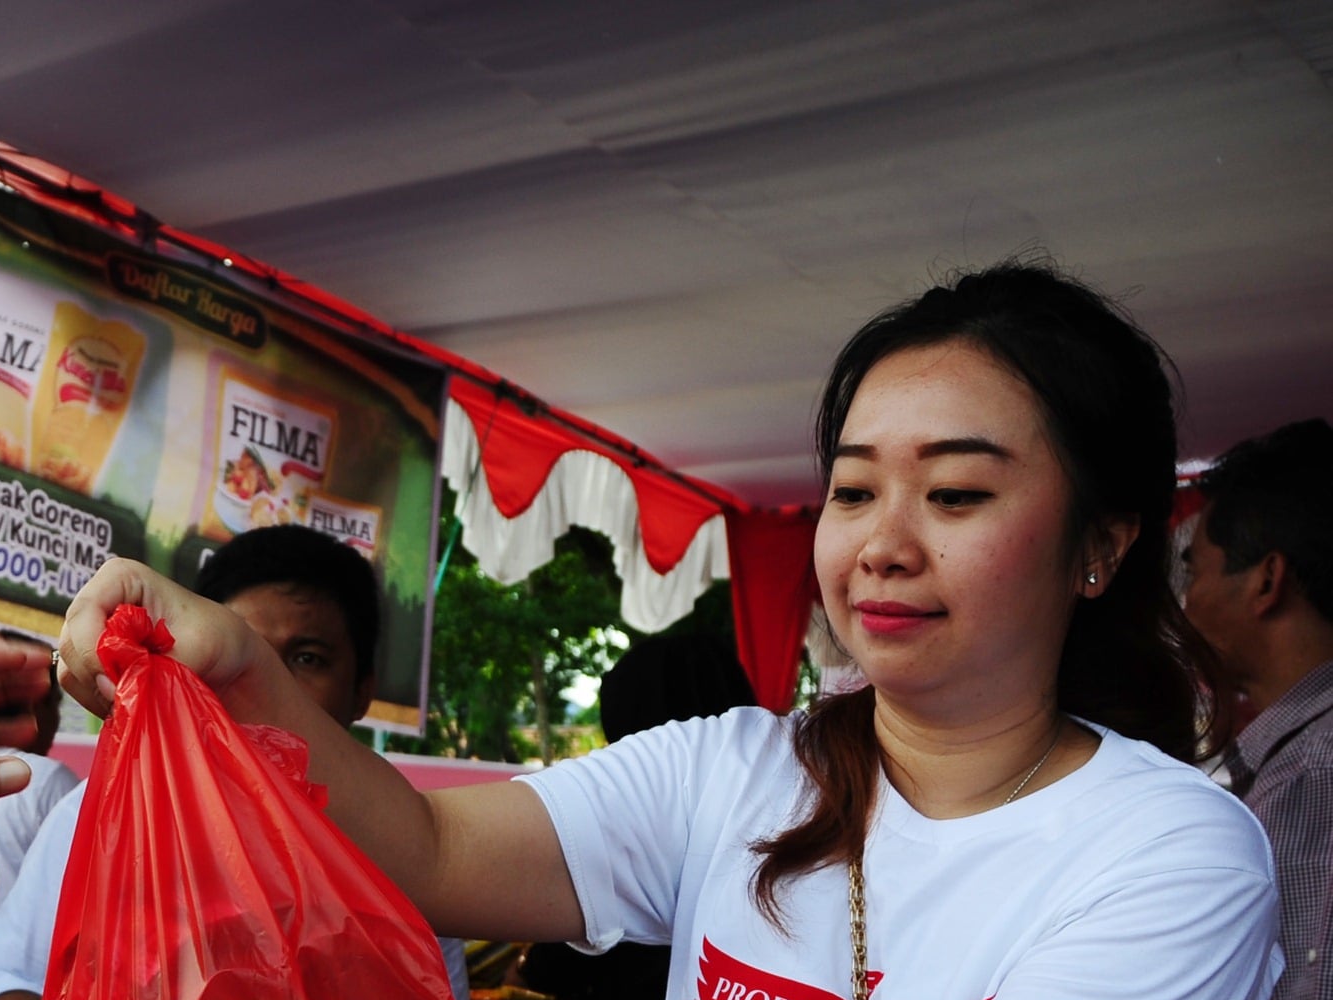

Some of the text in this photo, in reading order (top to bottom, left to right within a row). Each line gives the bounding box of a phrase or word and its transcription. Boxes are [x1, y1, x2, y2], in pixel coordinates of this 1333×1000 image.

[230, 404, 325, 467] FILMA
[11, 520, 68, 559] Kunci
[75, 542, 107, 571] Ma
[31, 495, 109, 547] Goreng
[310, 508, 372, 541] FILMA
